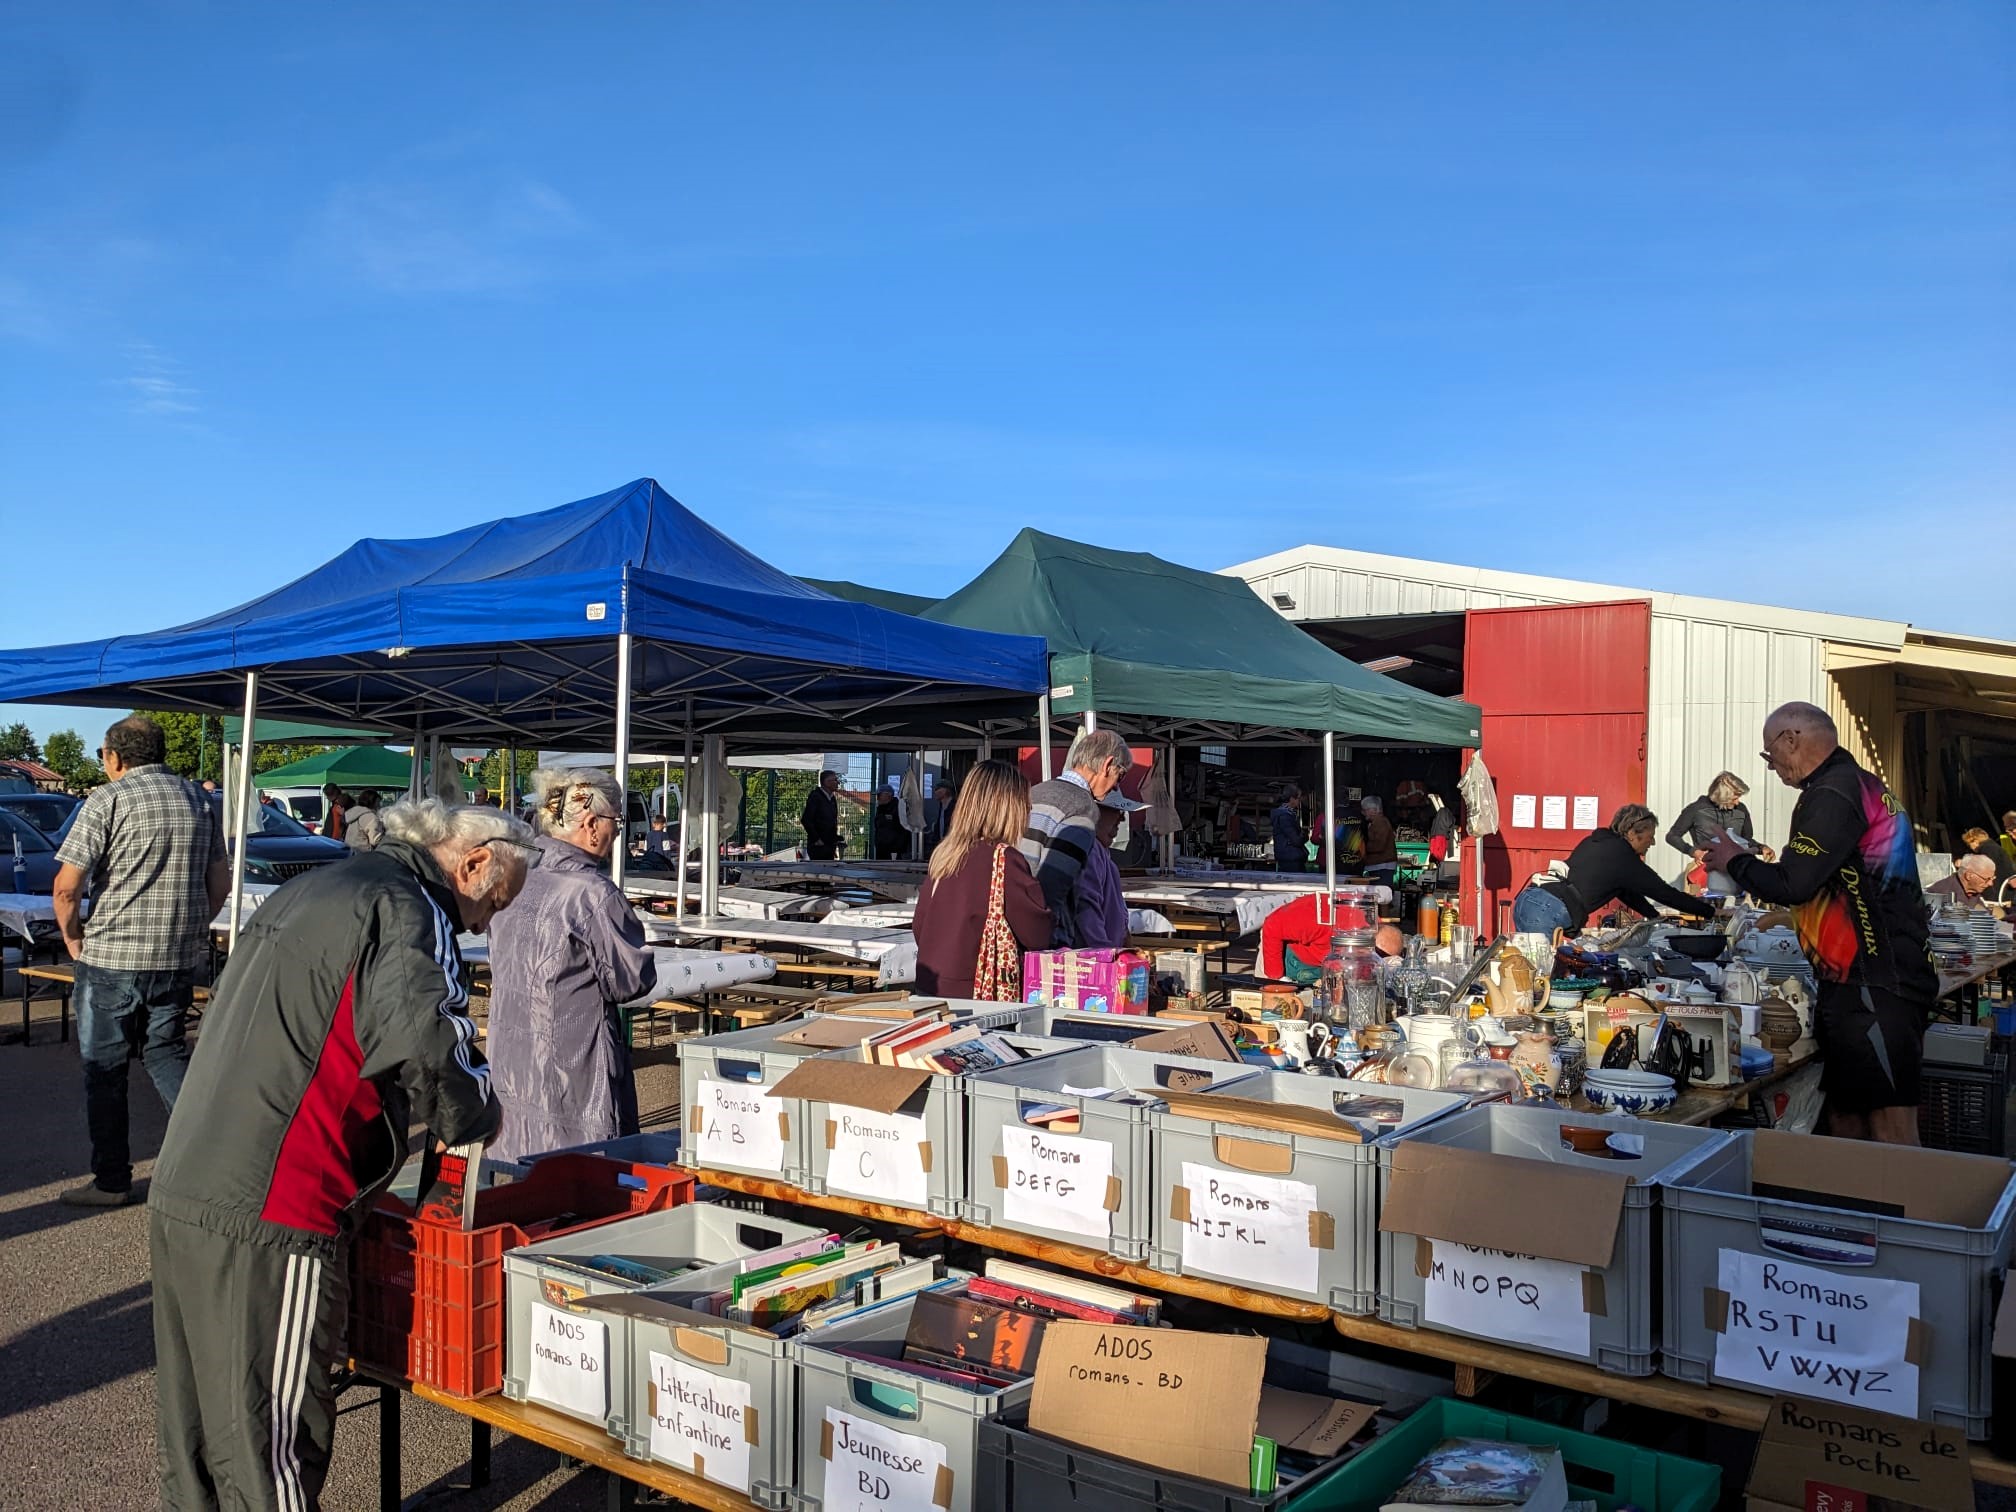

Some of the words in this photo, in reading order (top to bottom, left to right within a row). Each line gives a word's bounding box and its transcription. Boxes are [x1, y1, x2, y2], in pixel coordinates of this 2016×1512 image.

[715, 1088, 761, 1113] Romans
[843, 1115, 900, 1142] Romans
[859, 1151, 875, 1177] C
[1031, 1135, 1081, 1164] Romans
[1209, 1179, 1270, 1211] Romans
[1763, 1263, 1868, 1311] Romans
[549, 1313, 585, 1341] ADOS
[535, 1342, 572, 1366] romans
[580, 1352, 599, 1372] BD
[1094, 1333, 1153, 1361] ADOS
[1069, 1365, 1130, 1386] romans
[1158, 1372, 1183, 1389] BD
[660, 1366, 742, 1423] Littérature
[657, 1412, 732, 1451] enfantine
[1781, 1401, 1902, 1448] Romans
[1920, 1429, 1959, 1459] de
[837, 1420, 926, 1475] Jeunesse
[1823, 1442, 1921, 1482] Poche
[858, 1470, 890, 1500] BD
